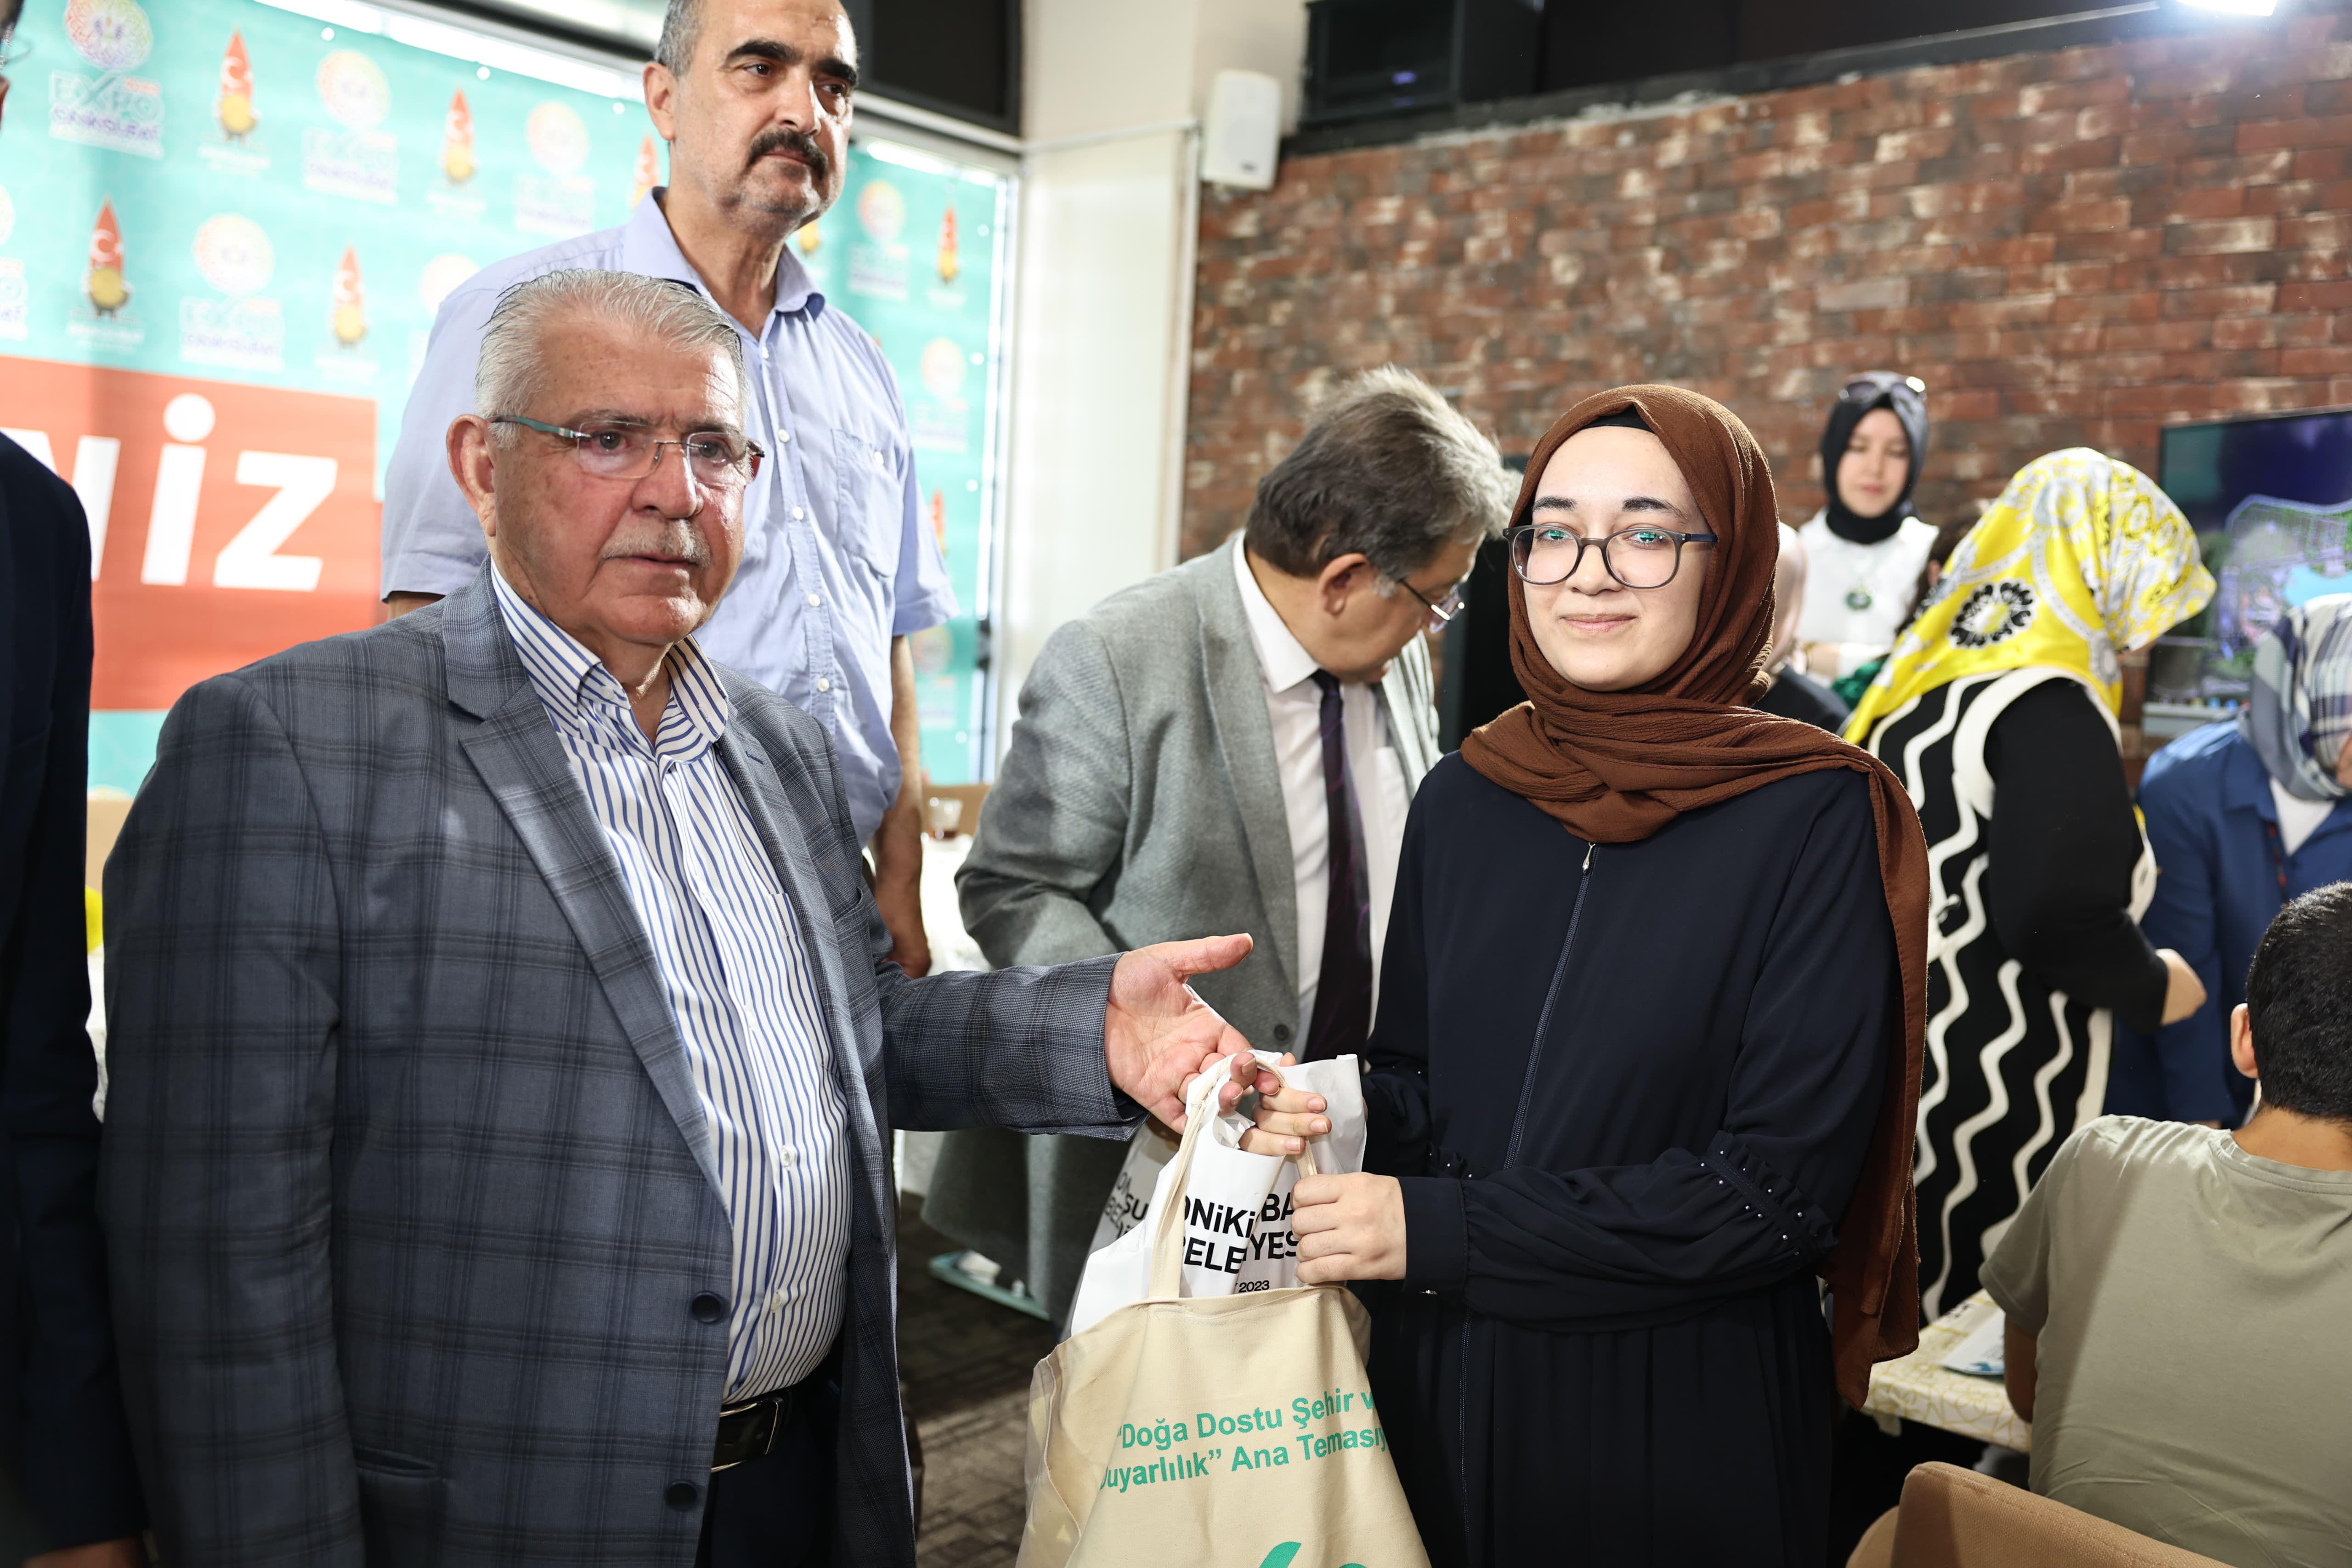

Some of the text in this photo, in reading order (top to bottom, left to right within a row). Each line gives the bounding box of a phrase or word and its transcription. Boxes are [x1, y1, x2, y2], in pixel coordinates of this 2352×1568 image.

[1238, 1280, 1270, 1293] 2023
[1196, 1407, 1283, 1438] Dostu
[1292, 1388, 1354, 1430] Şehir
[1232, 1446, 1289, 1471] Ana
